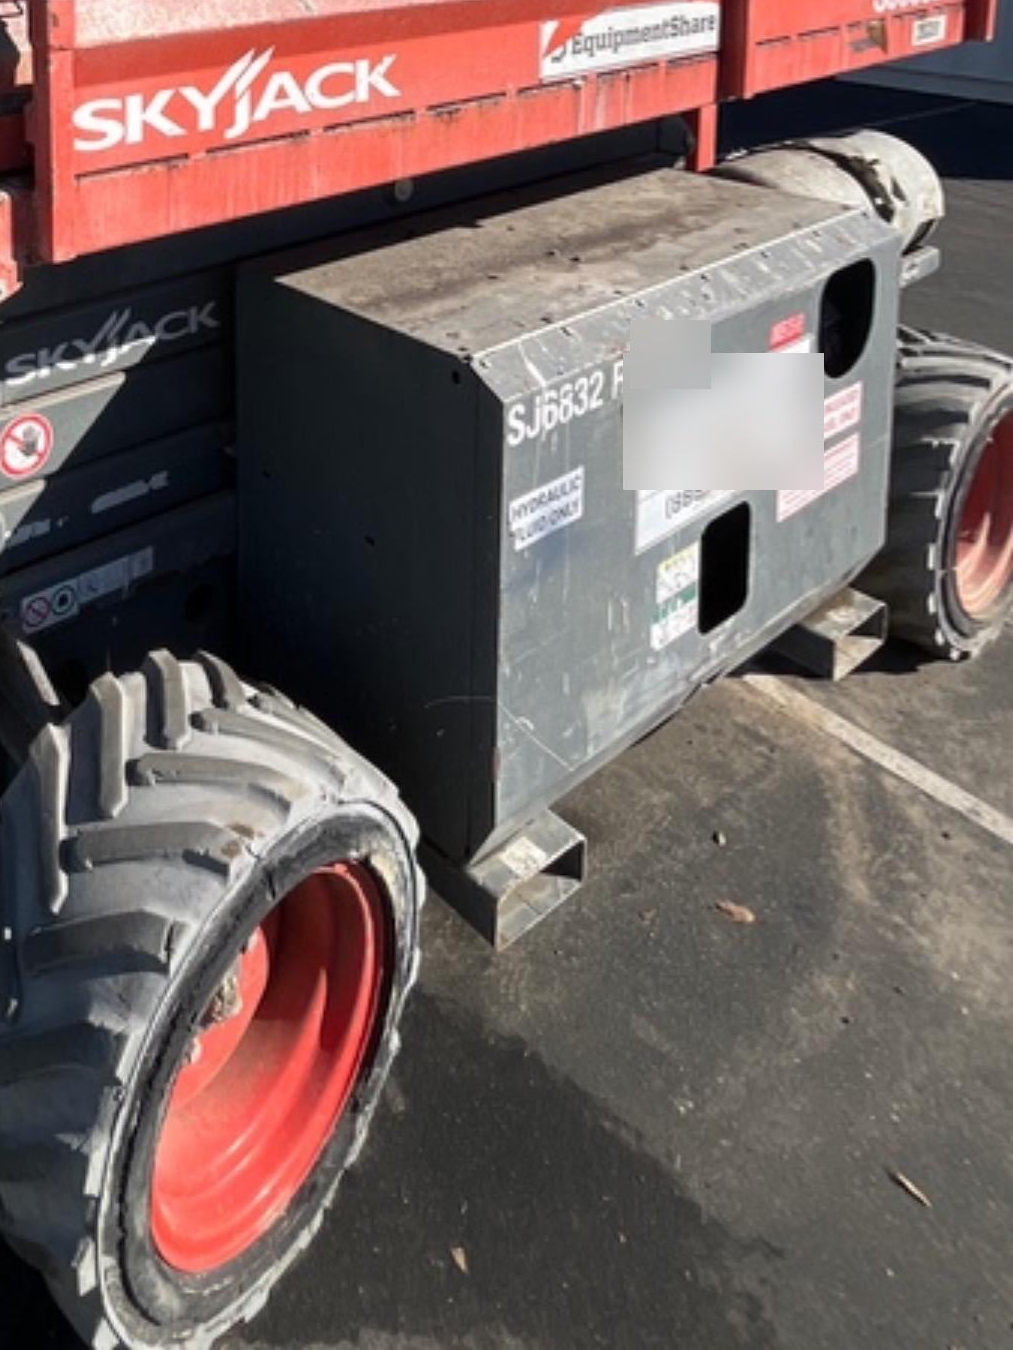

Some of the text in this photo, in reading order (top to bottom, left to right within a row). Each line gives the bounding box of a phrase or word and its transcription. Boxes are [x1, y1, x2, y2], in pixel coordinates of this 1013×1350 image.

[572, 14, 715, 57] EquipmentShare
[71, 45, 401, 151] SKYJACK
[6, 301, 222, 385] SKYJACK
[506, 370, 604, 448] SJ6832
[510, 473, 580, 519] HYDRAULIC
